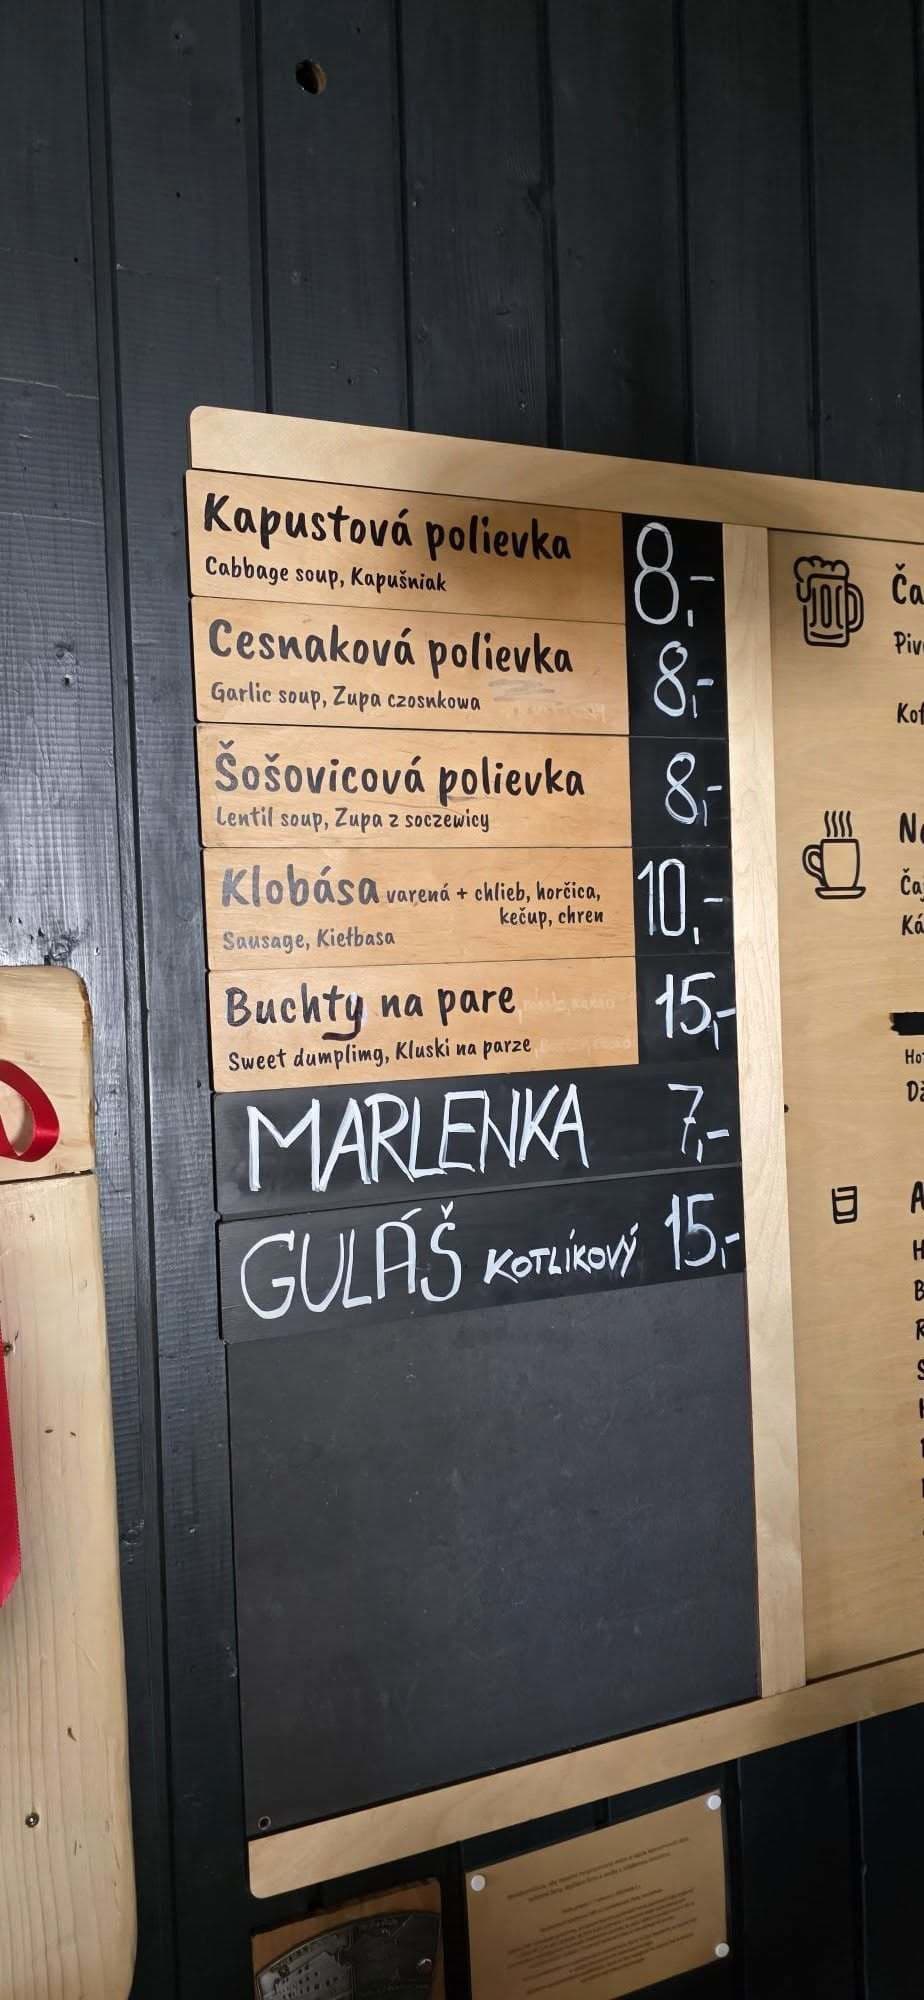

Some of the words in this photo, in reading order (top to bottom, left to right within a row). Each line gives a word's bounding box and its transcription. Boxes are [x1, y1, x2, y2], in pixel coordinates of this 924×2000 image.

[204, 493, 413, 549] Kapustová
[426, 517, 571, 561] polievka
[205, 556, 290, 585] Cabbage
[295, 565, 345, 590] soup,
[350, 570, 447, 593] Kapušniak
[633, 522, 715, 628] 8,-
[208, 619, 415, 667] Cesnaková
[430, 630, 573, 679] polievka
[894, 631, 924, 656] Piv
[211, 681, 272, 704] Garlic
[278, 686, 329, 710] soup,
[332, 684, 382, 711] Zupa
[388, 691, 481, 712] czosnkowa
[653, 640, 715, 718] 8,-
[214, 740, 425, 794] Šošovicová
[438, 755, 585, 807] polievka
[665, 751, 723, 827] 8,-
[215, 806, 273, 828] Lentil
[280, 808, 329, 832] soup,
[335, 806, 383, 832] Zupa
[388, 813, 400, 829] z
[405, 807, 490, 833] soczewicy
[221, 864, 380, 908] Klobása
[386, 883, 451, 906] varená
[474, 881, 531, 904] chlieb,
[536, 879, 601, 902] horčica,
[499, 906, 552, 929] kečup,
[558, 906, 603, 924] chren
[637, 858, 724, 945] 10,-
[223, 929, 310, 954] Sausage,
[316, 927, 395, 948] Kiełbasa
[225, 982, 364, 1041] Buchty
[380, 994, 423, 1018] na
[438, 984, 516, 1025] pare
[655, 972, 736, 1051] 15,-
[228, 1050, 287, 1072] Sweet
[395, 1039, 450, 1060] Kluski
[455, 1041, 477, 1056] na
[483, 1039, 532, 1059] parze
[246, 1083, 589, 1193] MARLENKA
[668, 1083, 729, 1163] 7,-
[240, 1201, 462, 1319] GULÁŠ
[483, 1223, 639, 1284] KOTLÍKOVÝ
[664, 1193, 741, 1270] 15,-
